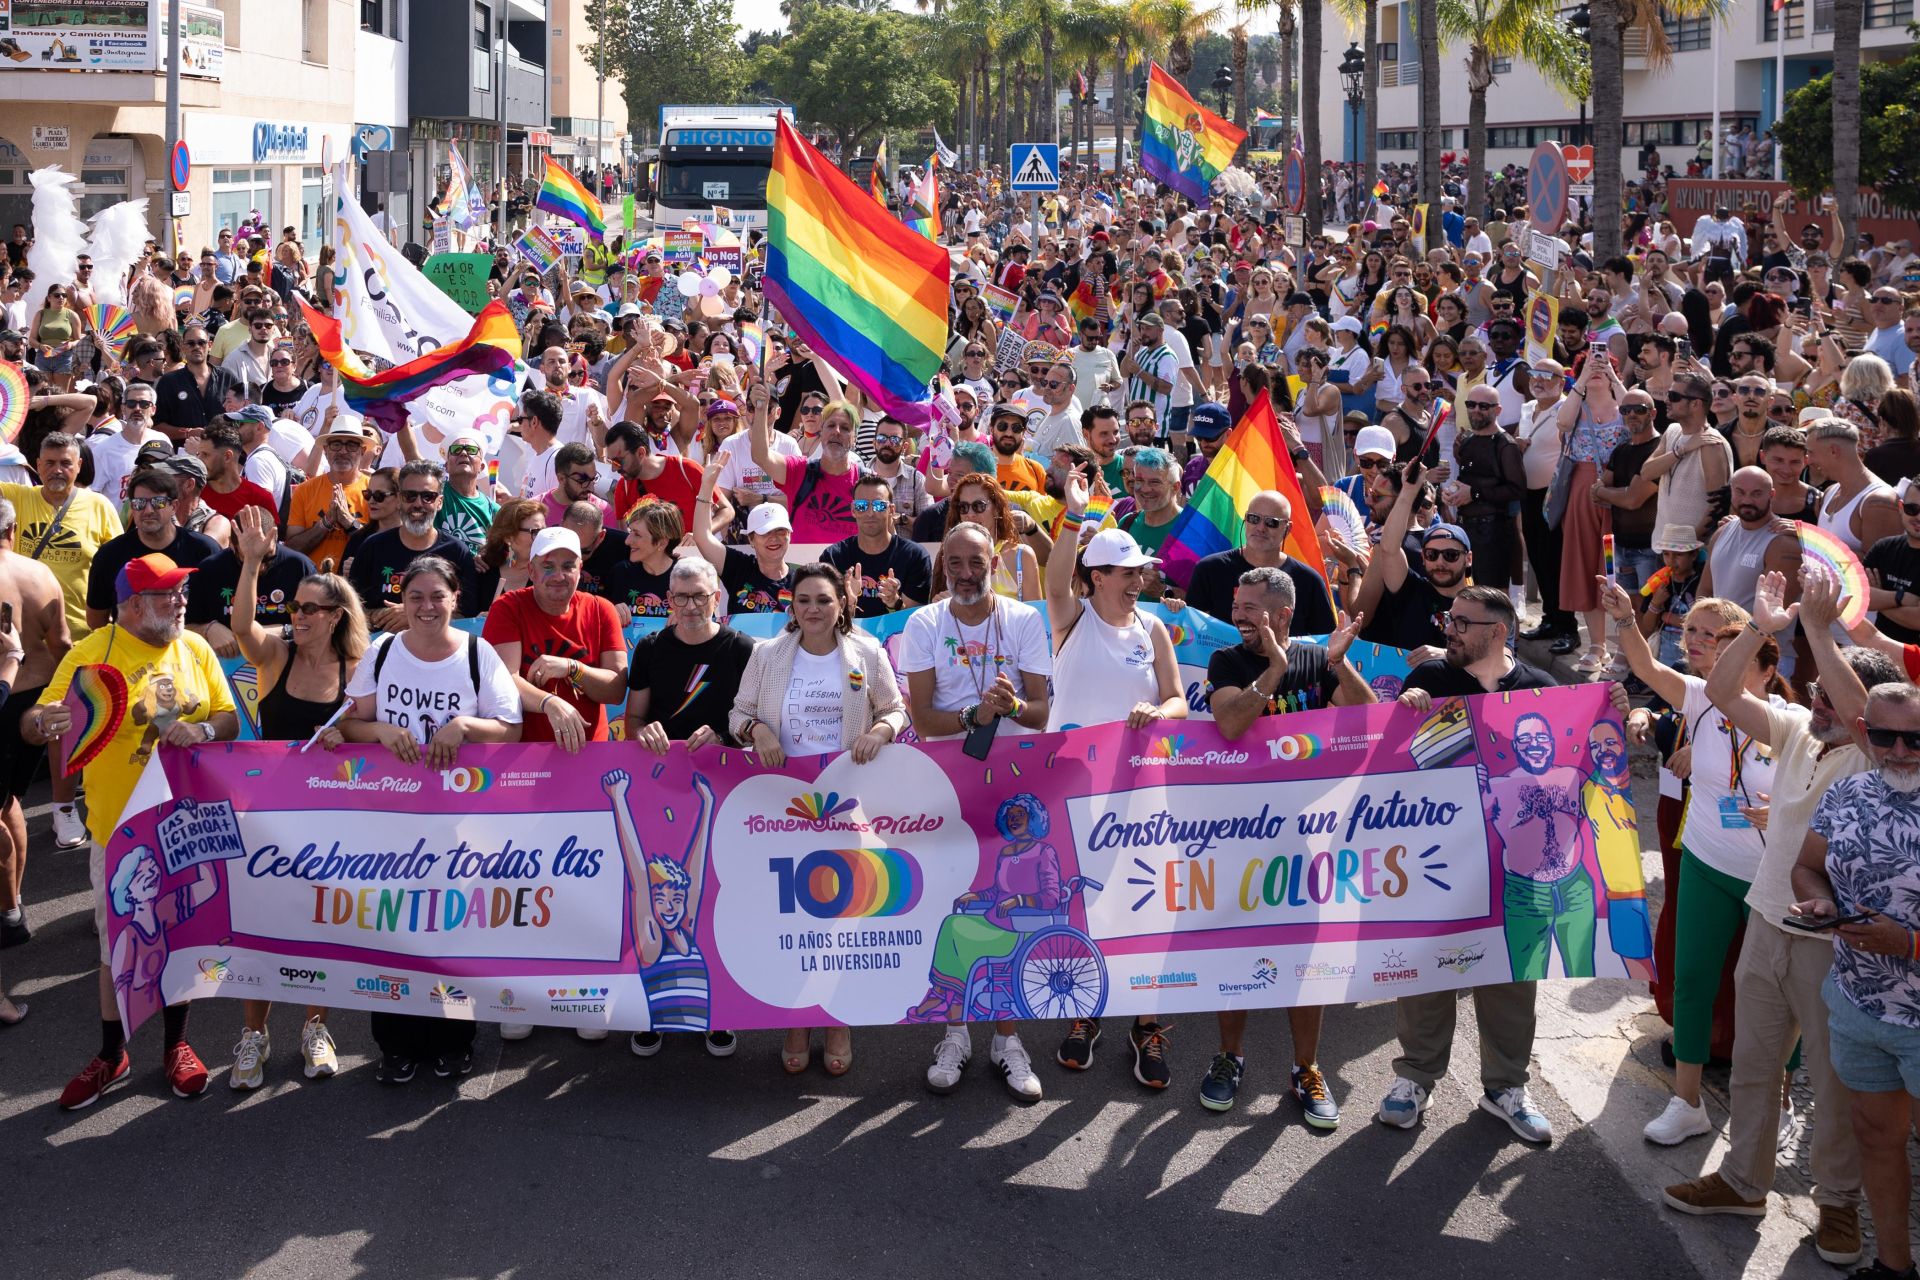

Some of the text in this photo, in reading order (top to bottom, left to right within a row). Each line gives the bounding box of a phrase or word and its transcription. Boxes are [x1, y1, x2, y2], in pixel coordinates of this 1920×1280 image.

[266, 119, 308, 151] Medident
[677, 131, 774, 145] HIGINIO
[1675, 187, 1772, 213] AYUNTAMIENTO
[525, 248, 544, 265] AGAIN
[705, 251, 739, 260] No Nos
[448, 274, 467, 286] ES
[996, 332, 1015, 369] FASCISM
[1192, 415, 1213, 424] adidas
[387, 684, 461, 711] POWER
[804, 690, 841, 699] LESBIAN
[384, 708, 409, 729] TO
[805, 716, 843, 728] STRAIGHT
[807, 733, 839, 742] HUMAN
[1337, 736, 1351, 744] AÑOS
[1351, 733, 1384, 743] CELEBRANDO
[1338, 743, 1369, 751] DIVERSIDAD
[1205, 750, 1249, 766] Pride
[507, 771, 521, 779] AÑOS
[521, 771, 552, 779] CELEBRANDO
[507, 779, 536, 787] DIVERSIDAD
[381, 775, 422, 793] Pride
[162, 804, 226, 836] LAS VIDAS
[869, 813, 945, 835] Pride
[1087, 790, 1463, 858] Construyendo un futuro
[165, 819, 232, 850] LGTBIQA+
[168, 833, 240, 868] IMPORTAN
[246, 834, 605, 881] Celebrando todas las
[1165, 844, 1409, 912] EN COLORES
[310, 885, 554, 933] IDENTIDADES
[778, 929, 922, 951] 10 AÑOS CELEBRANDO
[801, 952, 901, 972] LA DIVERSIDAD
[1437, 952, 1485, 968] Diver Senior
[1373, 968, 1419, 983] REYNAS
[356, 976, 410, 1000] colega
[1218, 982, 1267, 993] Diversport
[550, 1004, 606, 1014] MULTIPLEX
